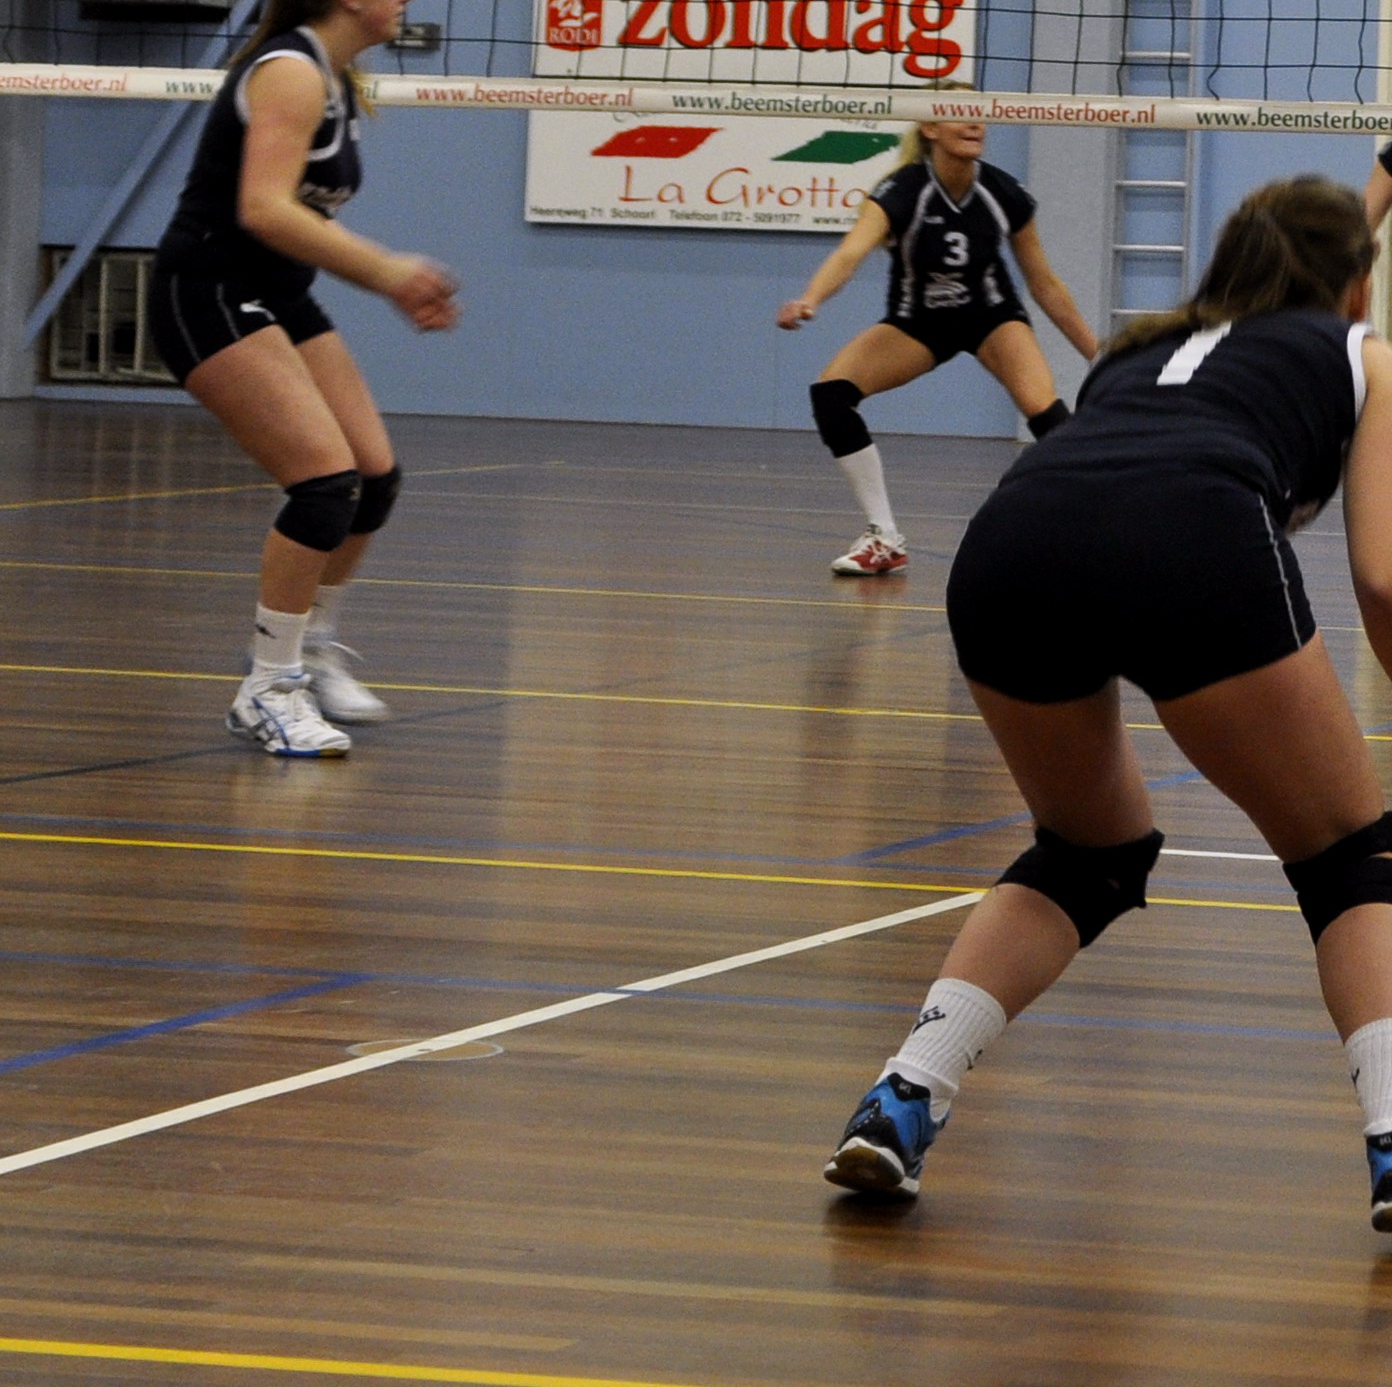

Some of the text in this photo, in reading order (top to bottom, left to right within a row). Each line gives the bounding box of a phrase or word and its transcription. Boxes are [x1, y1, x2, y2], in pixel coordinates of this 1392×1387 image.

[416, 84, 633, 108] www.beemsterboer.nl
[672, 92, 893, 115] www.beemsterboer.nl
[932, 100, 1157, 124] www.beemsterboer.nl
[618, 165, 685, 205] La
[944, 232, 969, 266] 3
